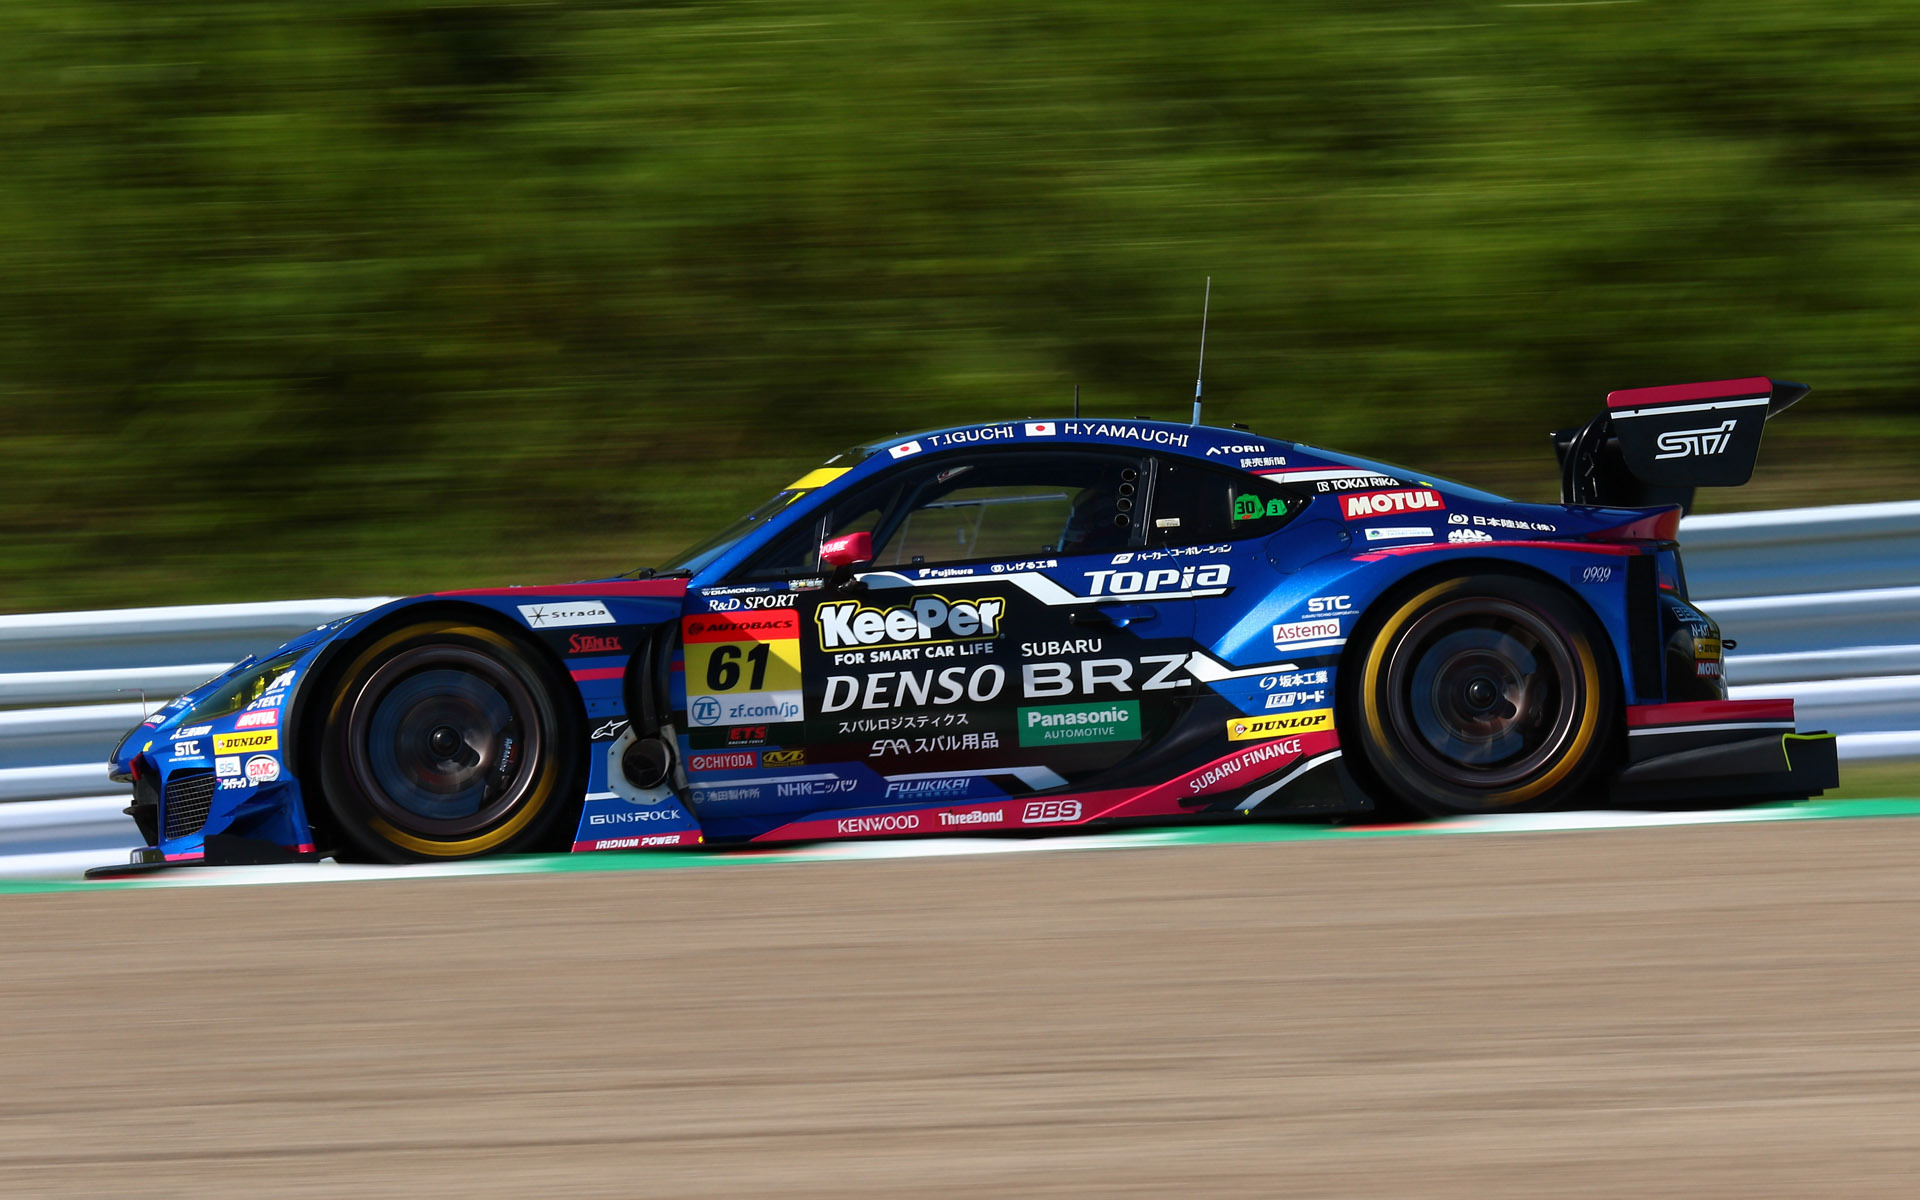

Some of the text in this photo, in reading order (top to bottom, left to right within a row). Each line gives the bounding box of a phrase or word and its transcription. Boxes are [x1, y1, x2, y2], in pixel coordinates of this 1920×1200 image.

[927, 426, 1014, 447] T.IGUCHI
[1064, 422, 1189, 448] H.YAMAUCHI
[1331, 478, 1400, 490] TOKAI RIKA
[1235, 500, 1255, 514] 30
[1271, 504, 1278, 514] 3
[1348, 491, 1439, 517] MOTUL
[1582, 566, 1611, 583] 999.9
[708, 594, 799, 612] R&D SPORT
[1308, 595, 1352, 612] STC
[551, 608, 606, 619] Strada
[706, 620, 793, 633] AUTOBACS
[819, 598, 1000, 648] KeePer
[1276, 623, 1338, 640] Astemo
[568, 633, 622, 653] STANLEY
[1021, 638, 1103, 657] SUBARU
[834, 642, 994, 666] FOR SMART CAR LIFE
[706, 643, 770, 692] 61
[1022, 653, 1192, 698] BRZ
[820, 664, 1006, 712] DENSO
[1297, 690, 1325, 705] リード
[729, 702, 799, 718] zf.com/jp
[1027, 706, 1129, 729] Panasonic
[237, 711, 276, 728] MOTUL
[839, 713, 969, 734] スバルロジスティクス
[1249, 715, 1327, 732] DUNLOP
[226, 735, 272, 748] DUNLOP
[729, 726, 768, 740] ETS
[1044, 726, 1115, 740] AUTOMOTIVE
[174, 740, 200, 757] STC
[915, 732, 999, 753] スバル用品
[249, 762, 276, 777] BMC
[705, 754, 753, 769] CHIYODA
[1190, 738, 1302, 794] SUBARU FINANCE
[885, 778, 970, 798] FUJIKIKAI
[590, 809, 681, 825] GUNSROCK
[938, 810, 1003, 826] ThreeBond
[1023, 801, 1082, 823] BBS
[837, 814, 919, 833] KENWOOD
[595, 835, 681, 850] IRIDIUM POWER
